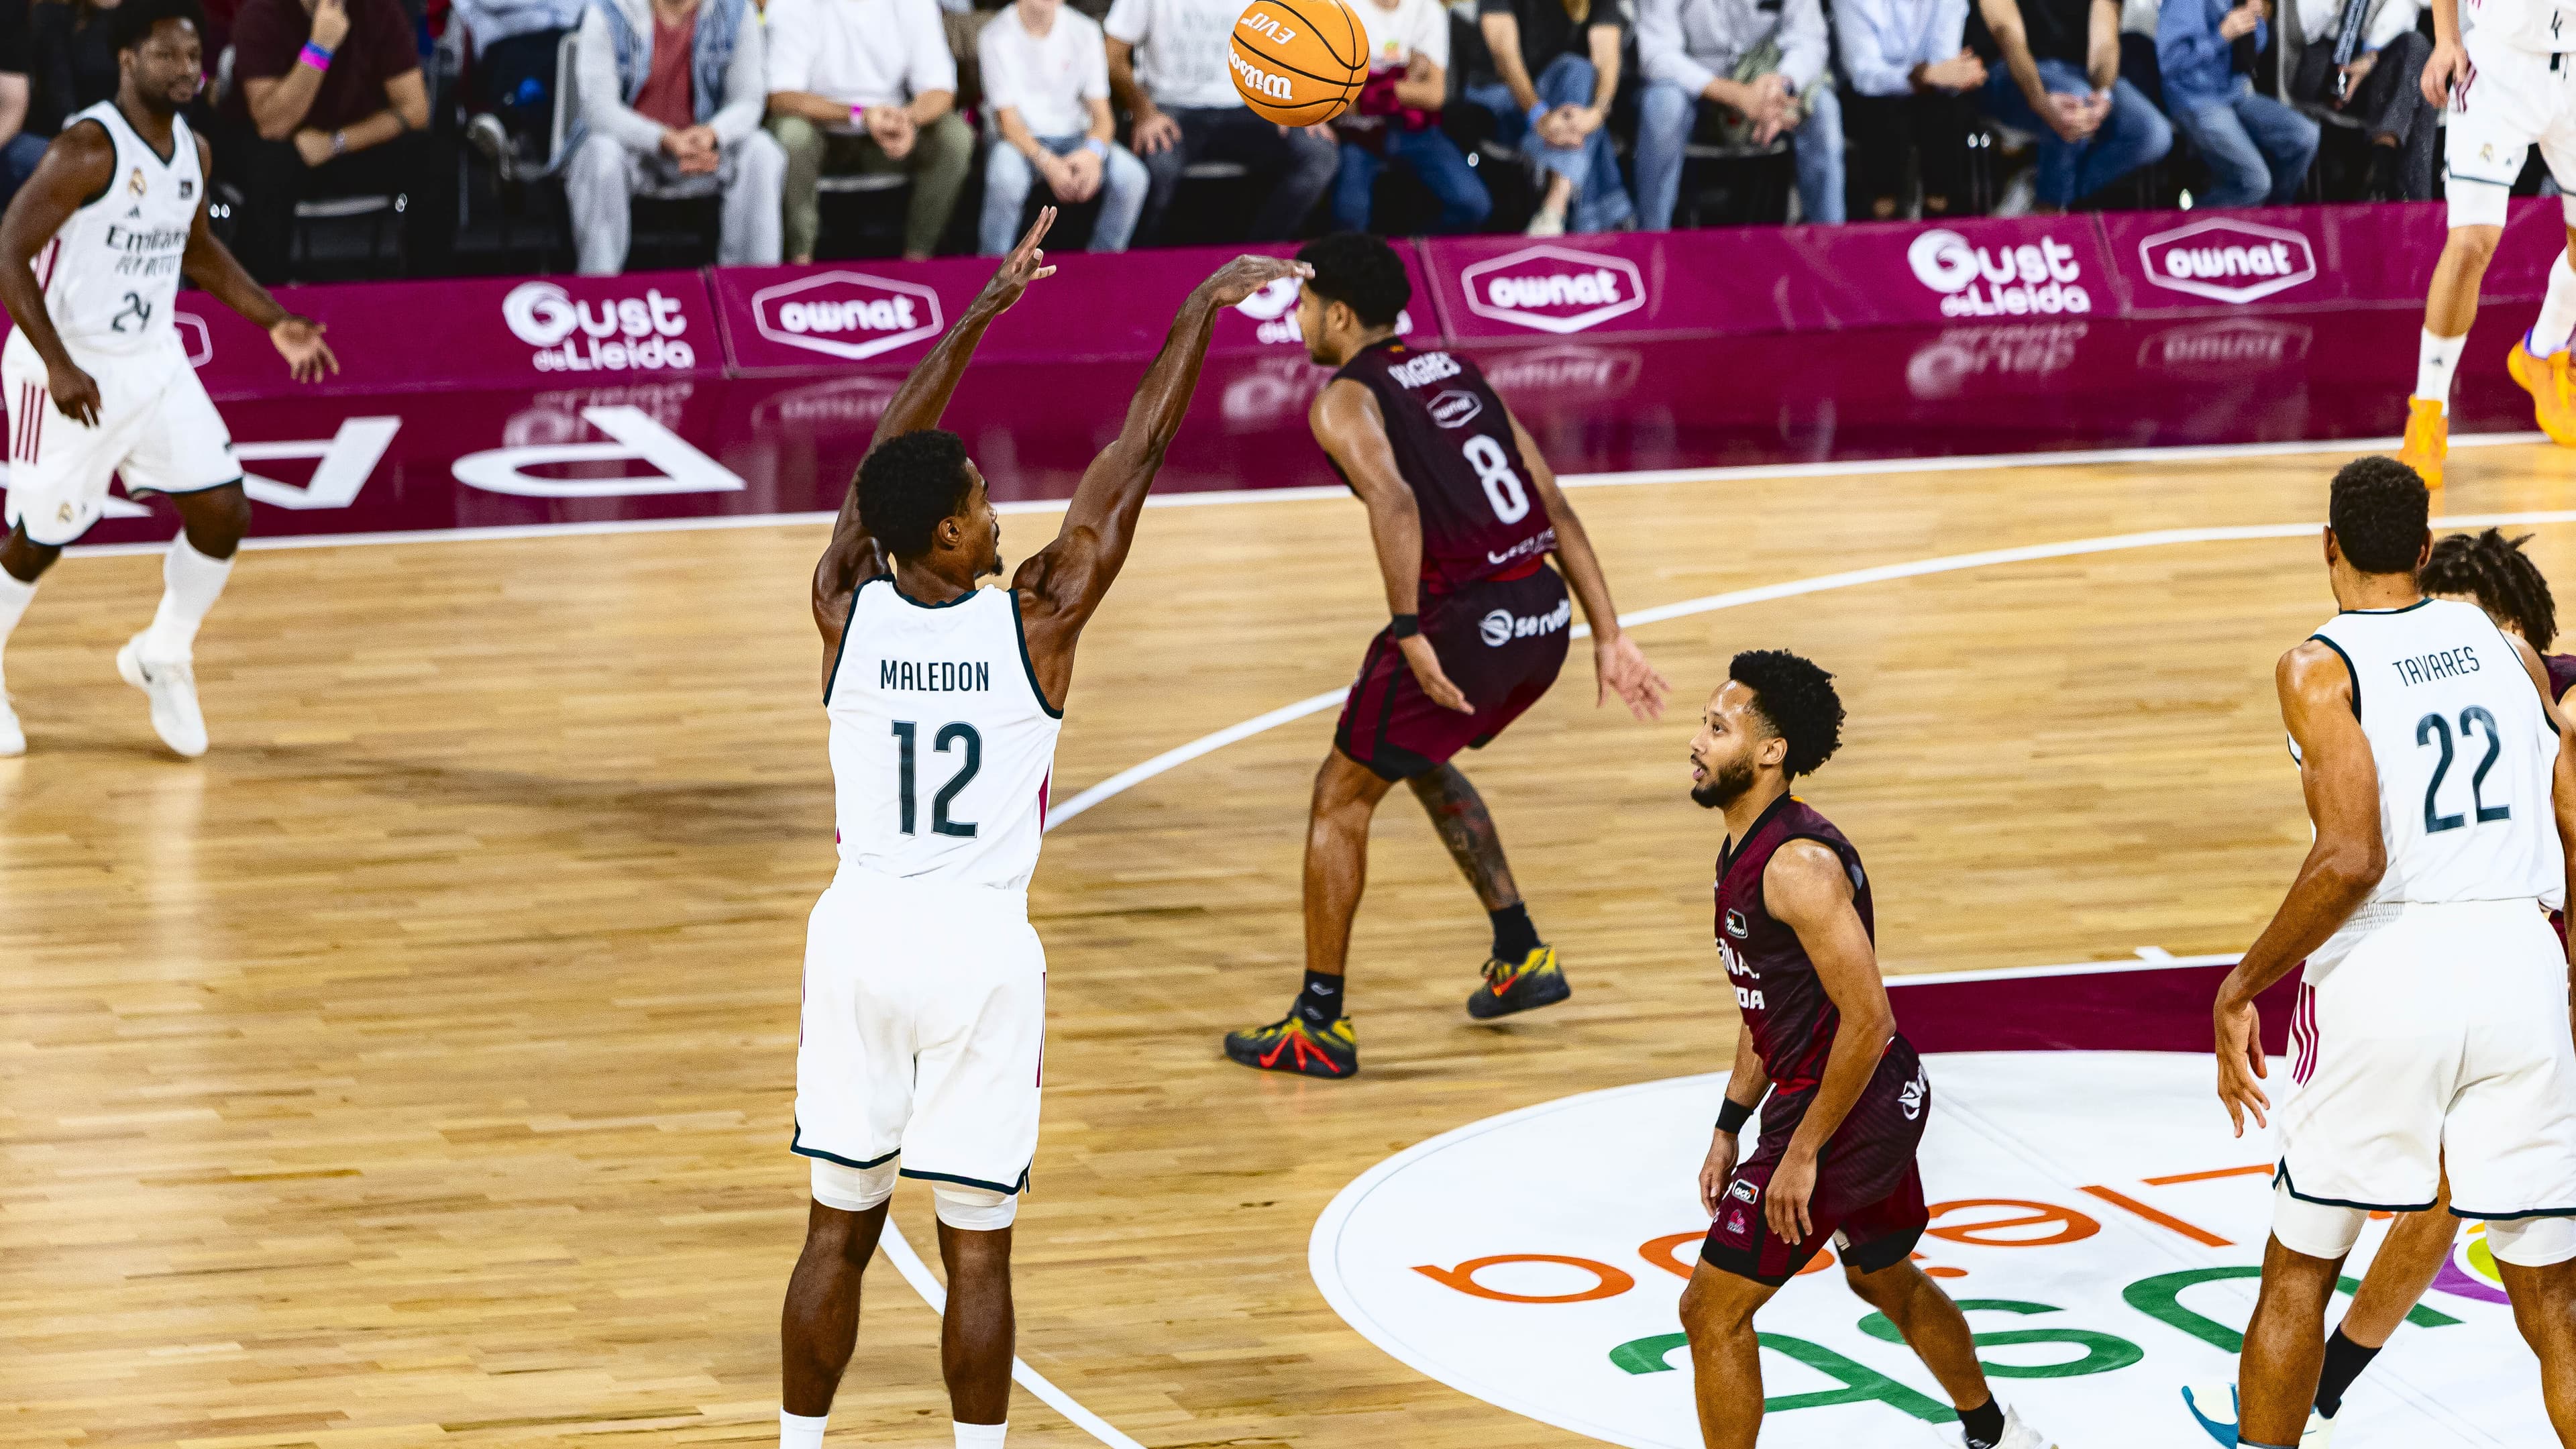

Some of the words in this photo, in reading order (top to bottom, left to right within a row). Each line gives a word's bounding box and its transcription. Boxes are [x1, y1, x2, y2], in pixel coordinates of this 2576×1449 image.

[1229, 42, 1293, 100] Wilson
[1907, 228, 2080, 294] Gust
[2165, 240, 2293, 278] ownat
[112, 291, 152, 333] 24
[502, 280, 688, 347] Gust
[1488, 269, 1621, 308] ownat
[779, 294, 917, 334] ownat
[1462, 434, 1530, 525] 8
[880, 659, 989, 692] MALEDON
[2392, 646, 2481, 687] TAVARES
[891, 719, 983, 839] 12
[2416, 704, 2512, 836] 22
